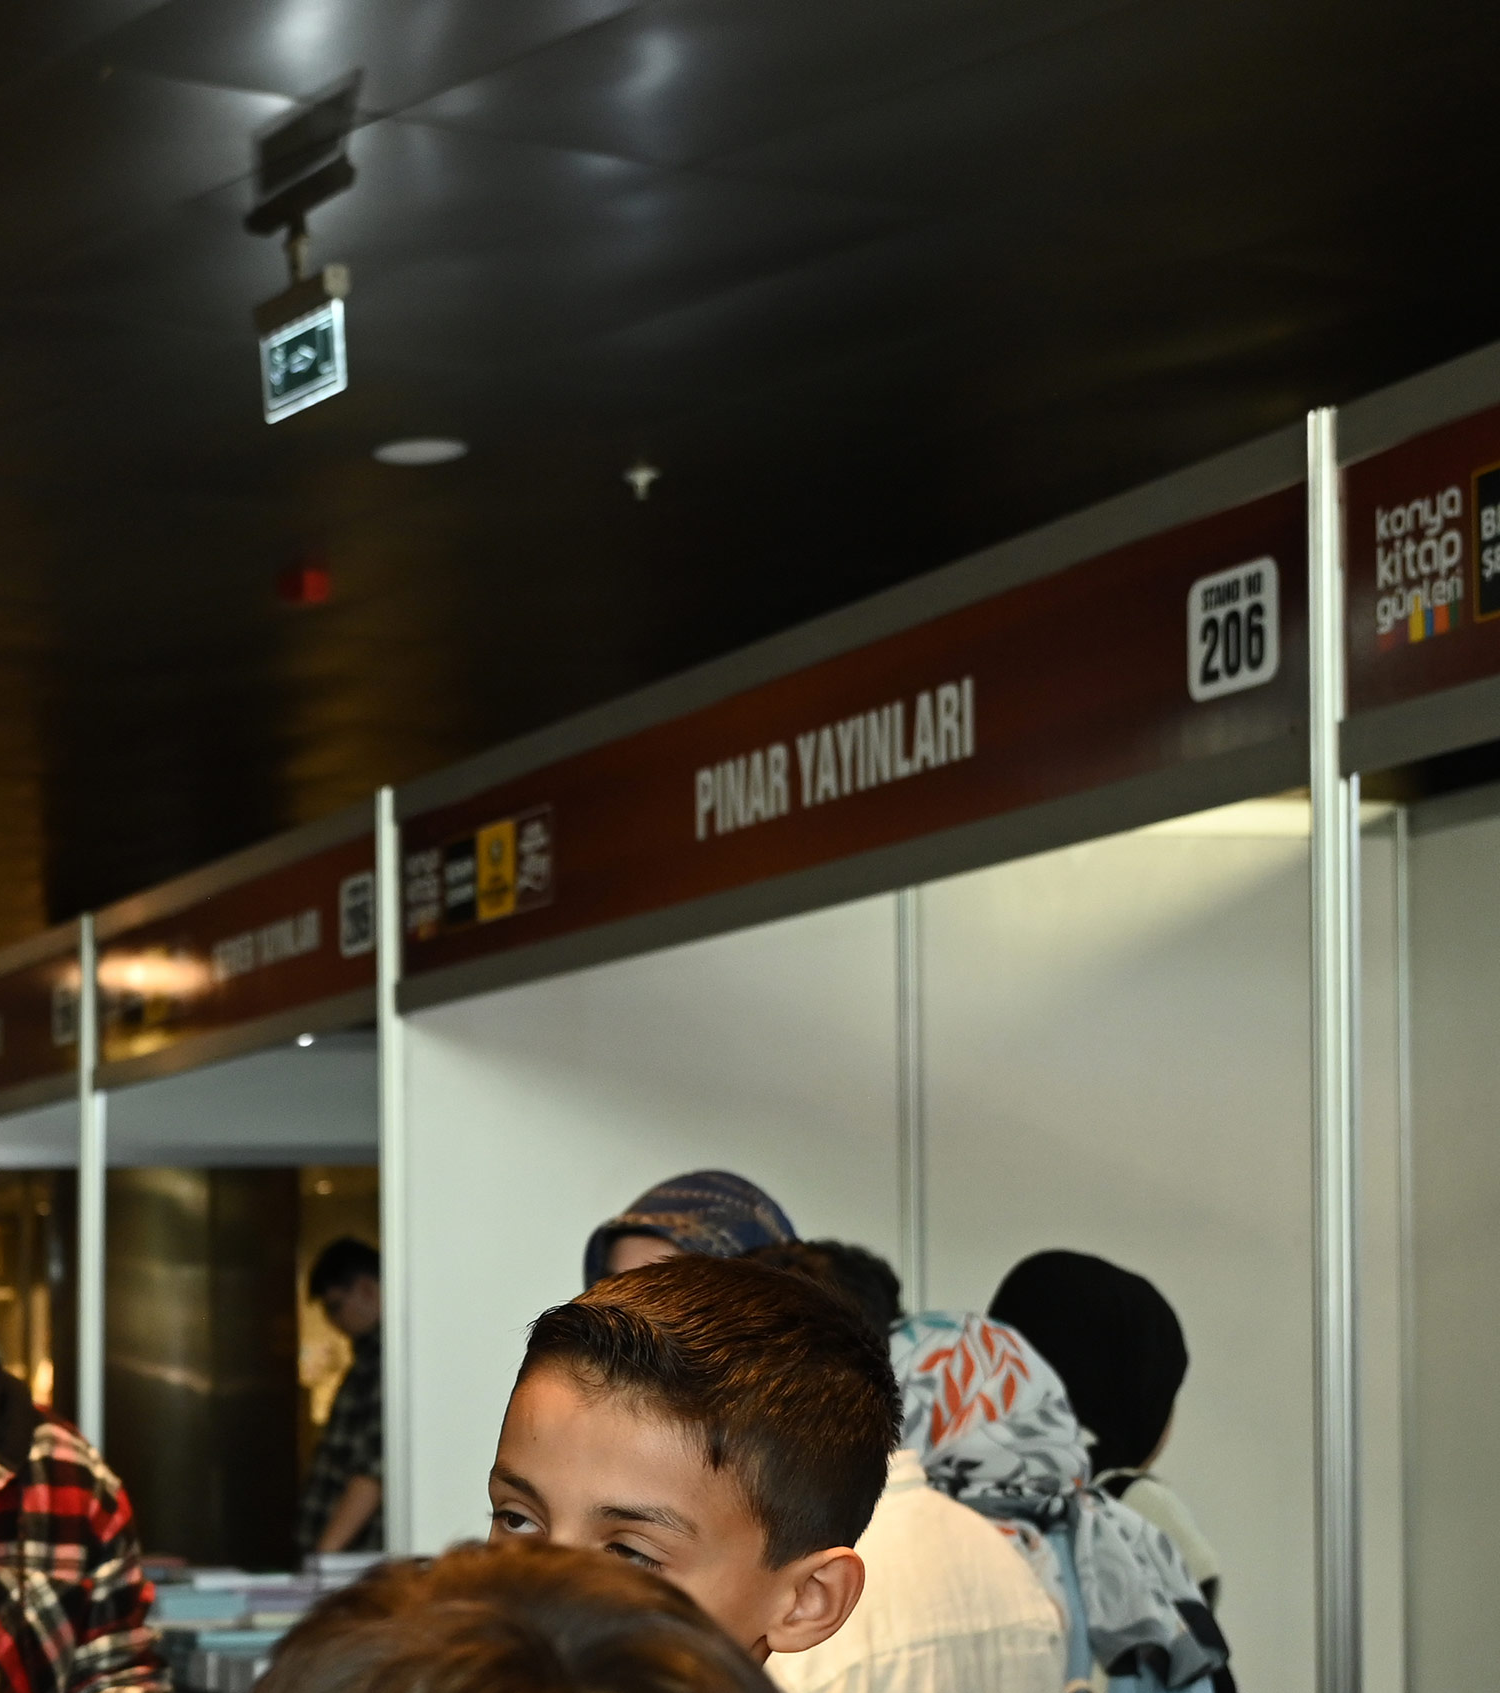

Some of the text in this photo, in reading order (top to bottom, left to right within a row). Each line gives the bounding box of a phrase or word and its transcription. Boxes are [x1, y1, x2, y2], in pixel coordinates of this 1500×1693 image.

[1376, 486, 1462, 541] konya
[1377, 530, 1462, 591] kitap
[1202, 571, 1262, 612] STAND NO
[1201, 603, 1265, 686] 206
[695, 676, 974, 841] PINAR YAYINLARI
